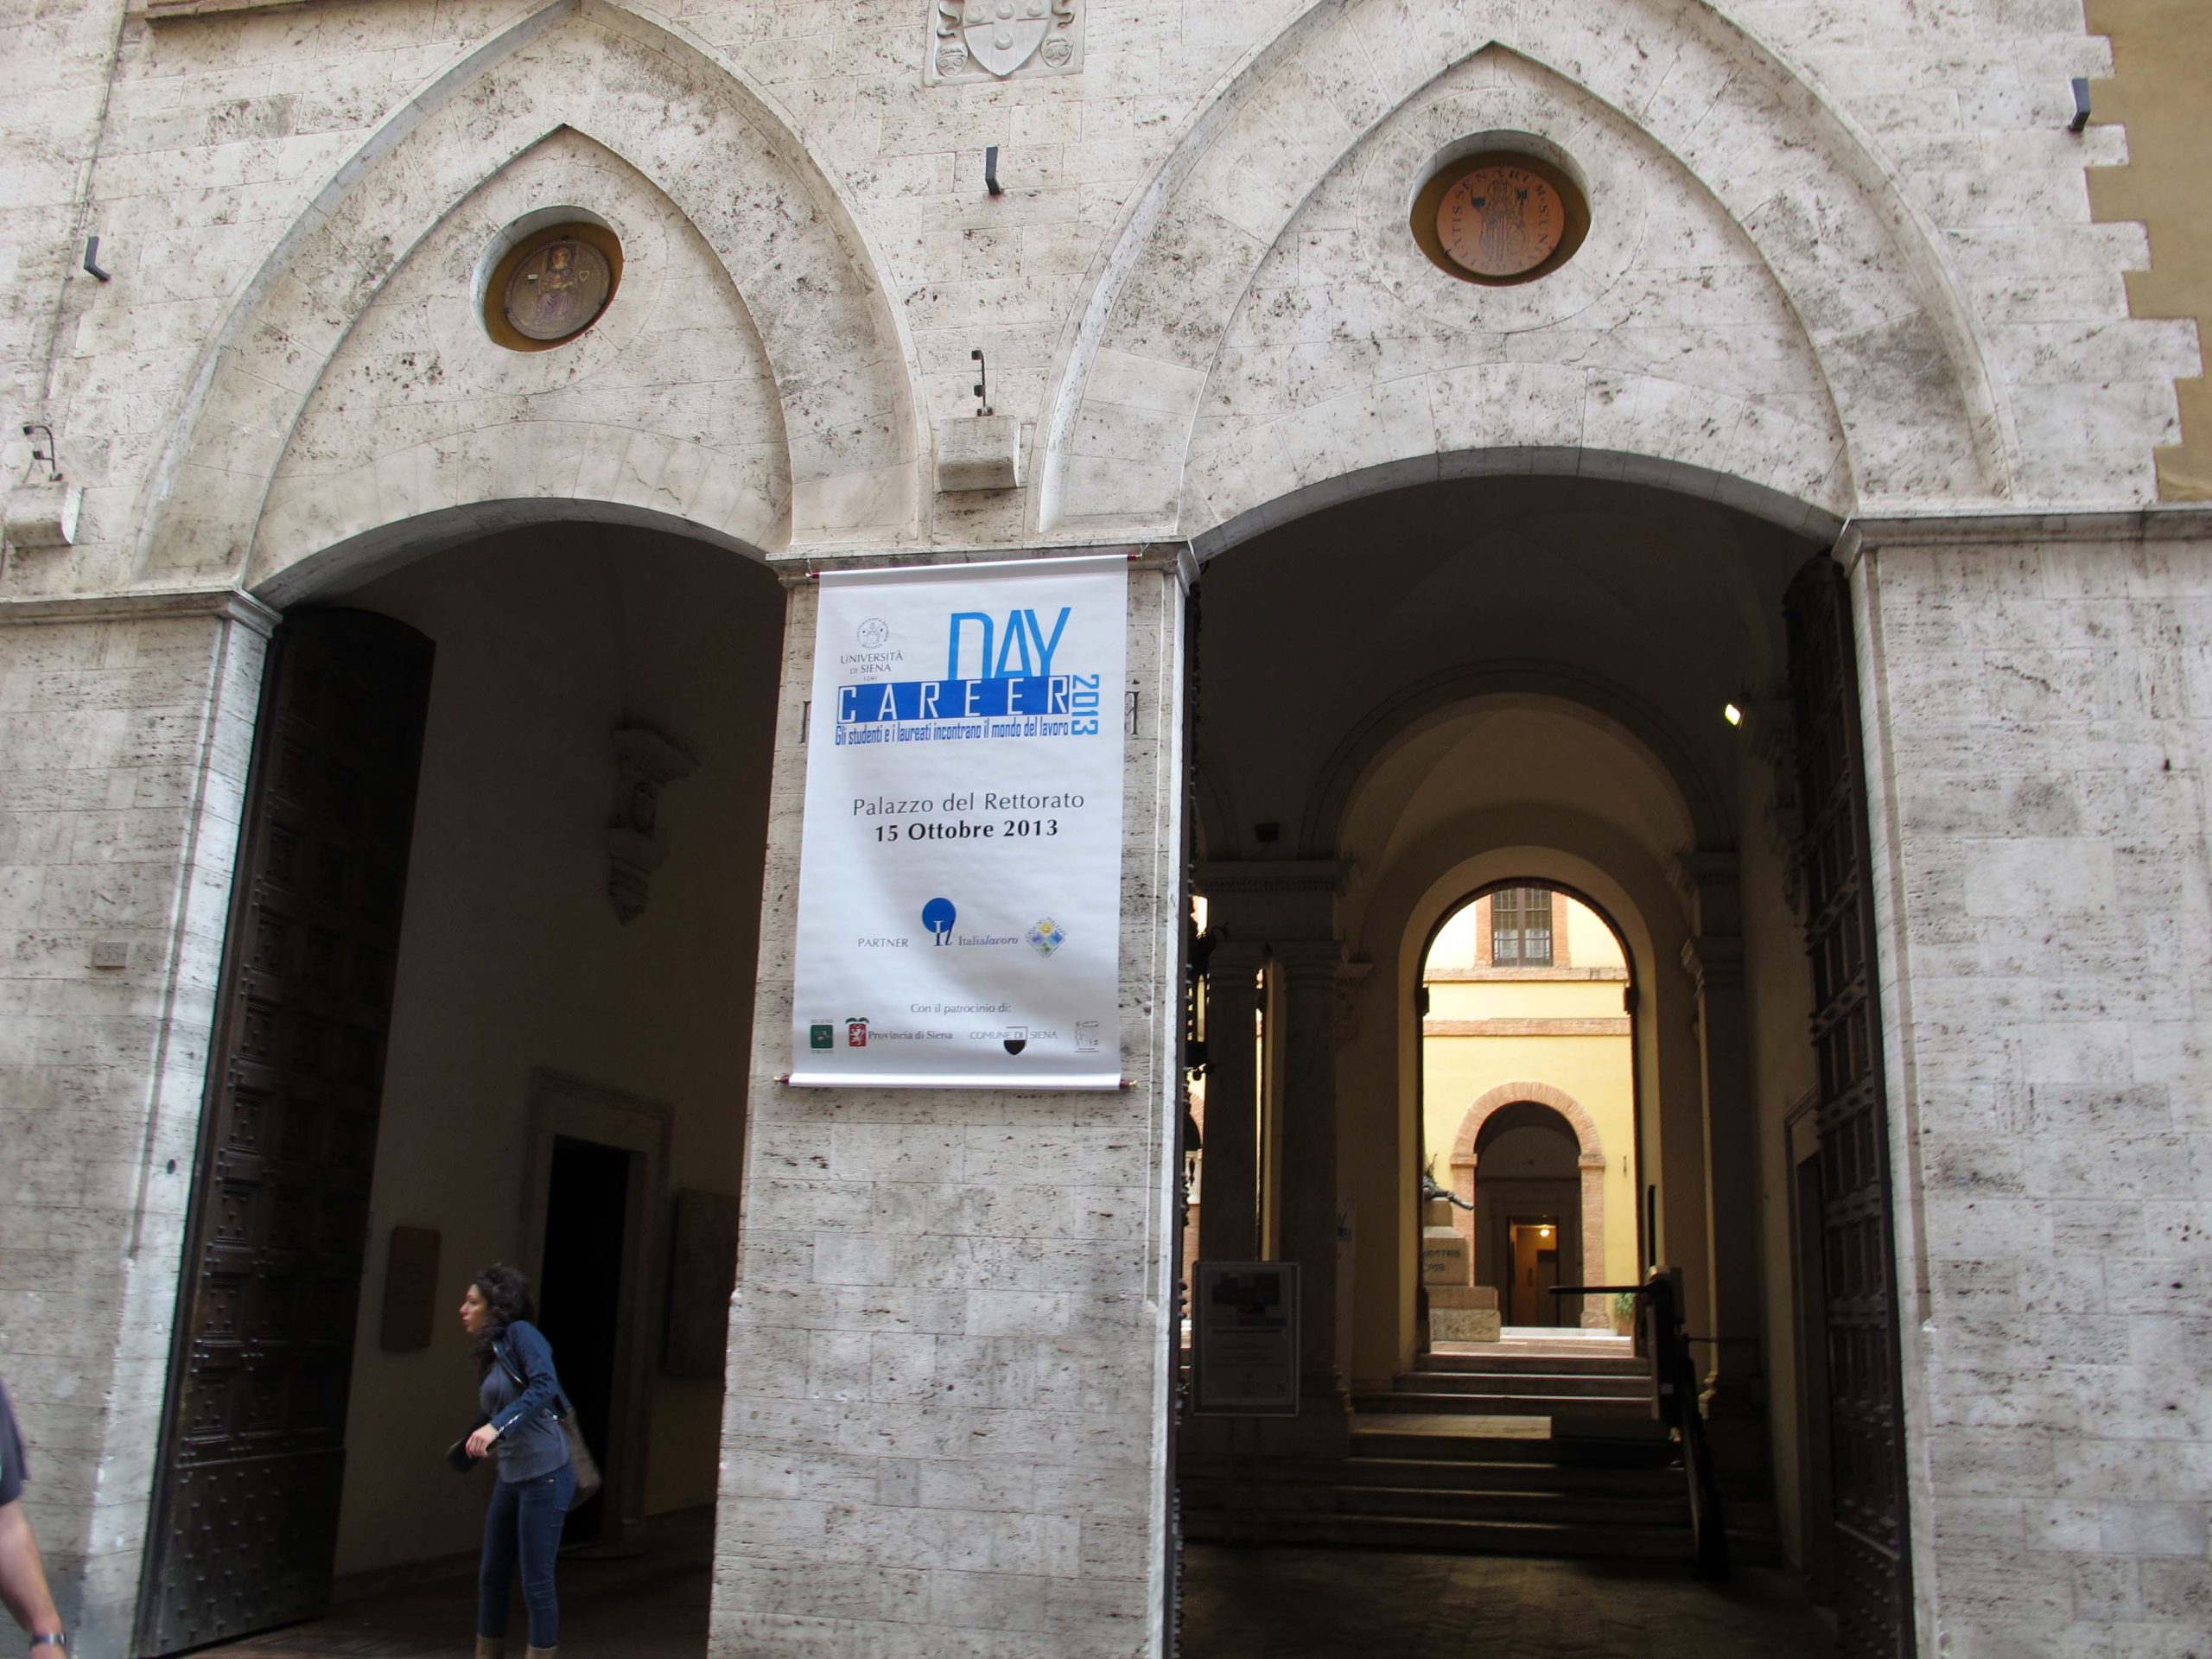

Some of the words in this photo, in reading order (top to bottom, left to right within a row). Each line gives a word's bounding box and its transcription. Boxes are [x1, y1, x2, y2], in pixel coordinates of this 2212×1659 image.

[948, 607, 1071, 680] DAY
[841, 651, 903, 664] UNIVERSITÀ
[861, 664, 892, 674] SIENA
[838, 677, 1068, 723] CAREER
[1071, 674, 1099, 735] 2013
[836, 725, 846, 746] Gli
[848, 723, 883, 745] studenti
[885, 729, 890, 742] e
[892, 723, 896, 742] i
[897, 721, 932, 742] laureati
[933, 721, 982, 741] incontrano
[983, 718, 989, 739] il
[992, 717, 1020, 738] mondo
[1024, 716, 1038, 737] del
[1039, 716, 1069, 737] lavoro
[853, 796, 934, 816] Palazzo
[943, 792, 975, 811] del
[985, 792, 1085, 810] Rettorato
[874, 824, 899, 842] 15
[908, 820, 995, 840] Ottobre
[1003, 819, 1058, 837] 2013
[857, 938, 909, 948] PARTNER
[910, 1003, 931, 1013] Con
[934, 1002, 941, 1013] il
[944, 1002, 995, 1015] patrocinio
[998, 1002, 1011, 1013] di:
[868, 1030, 913, 1039] Provincia
[915, 1030, 925, 1039] di
[926, 1031, 953, 1039] Siena
[969, 1031, 1011, 1039] COMUNE
[1029, 1031, 1058, 1039] SIENA
